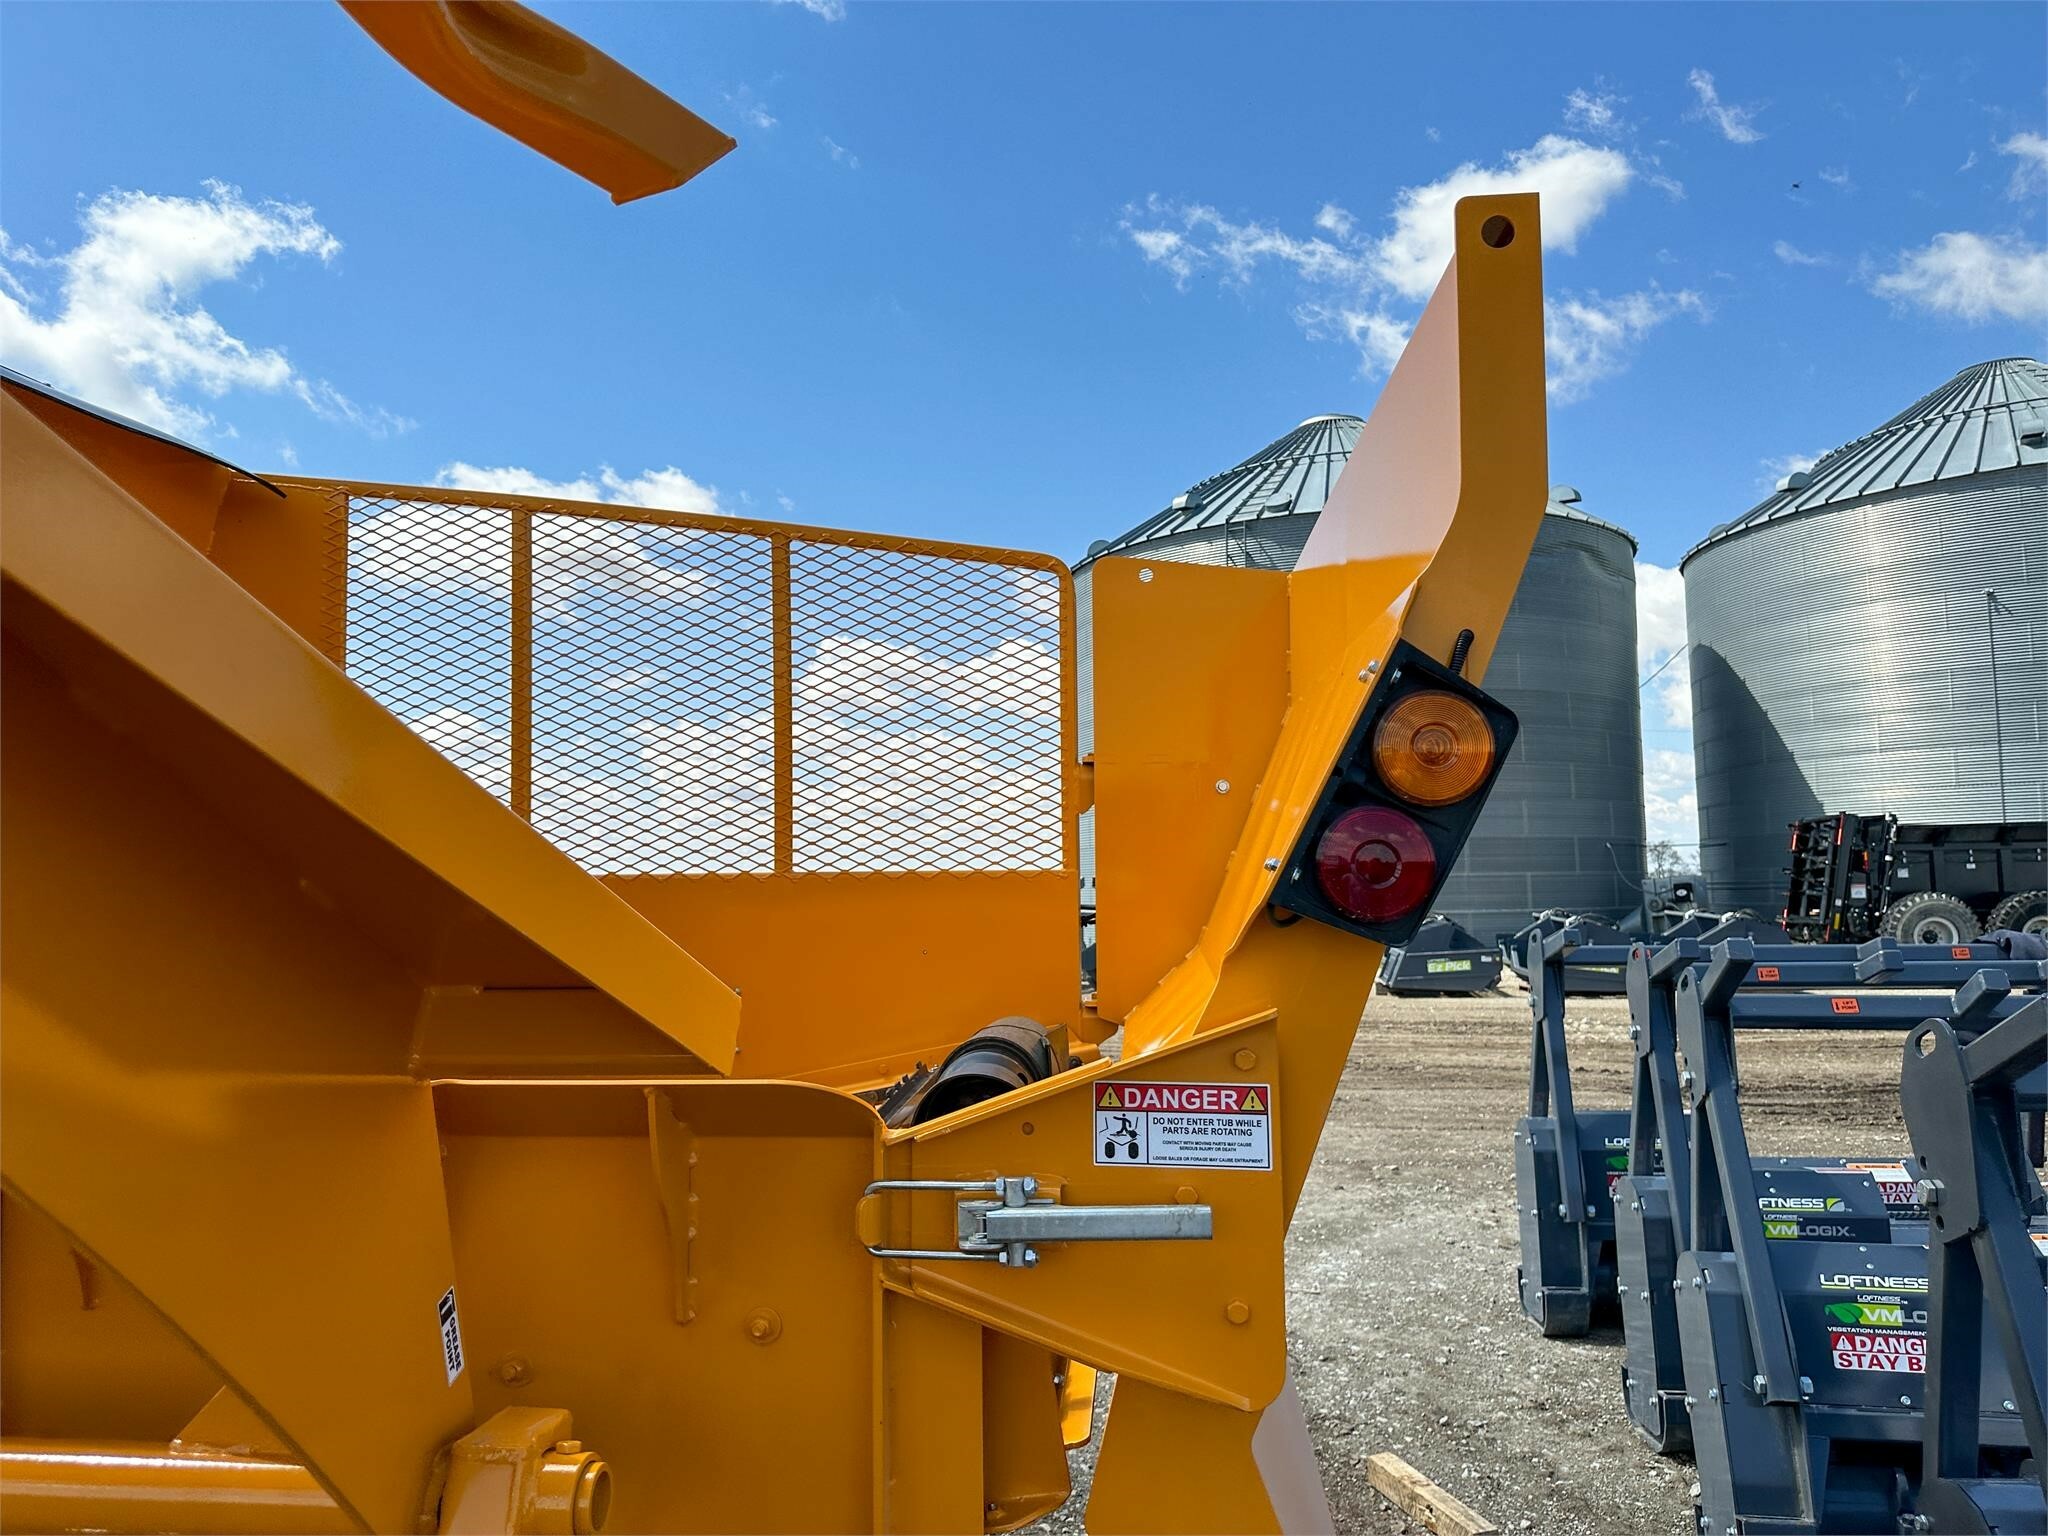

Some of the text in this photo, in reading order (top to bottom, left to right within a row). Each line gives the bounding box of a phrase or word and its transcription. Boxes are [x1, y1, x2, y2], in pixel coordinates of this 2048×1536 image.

[1124, 1087, 1239, 1110] DANGER
[1152, 1117, 1262, 1128] DO NOT ENTER TUB WHILE
[1162, 1126, 1253, 1137] PARTS ARE ROTATING
[1886, 1183, 1917, 1193] DAN
[1758, 1197, 1824, 1209] FTNESS
[1767, 1224, 1850, 1237] VMLOGIX
[1820, 1274, 1929, 1289] LOFTNESS
[1857, 1294, 1901, 1302] LOFTNESS
[1863, 1308, 1928, 1324] VMLO
[1827, 1326, 1874, 1334] VEGETATION
[445, 1329, 455, 1371] POINT
[449, 1316, 462, 1372] GREASE
[1854, 1335, 1927, 1355] DANG
[1838, 1352, 1900, 1371] STAY
